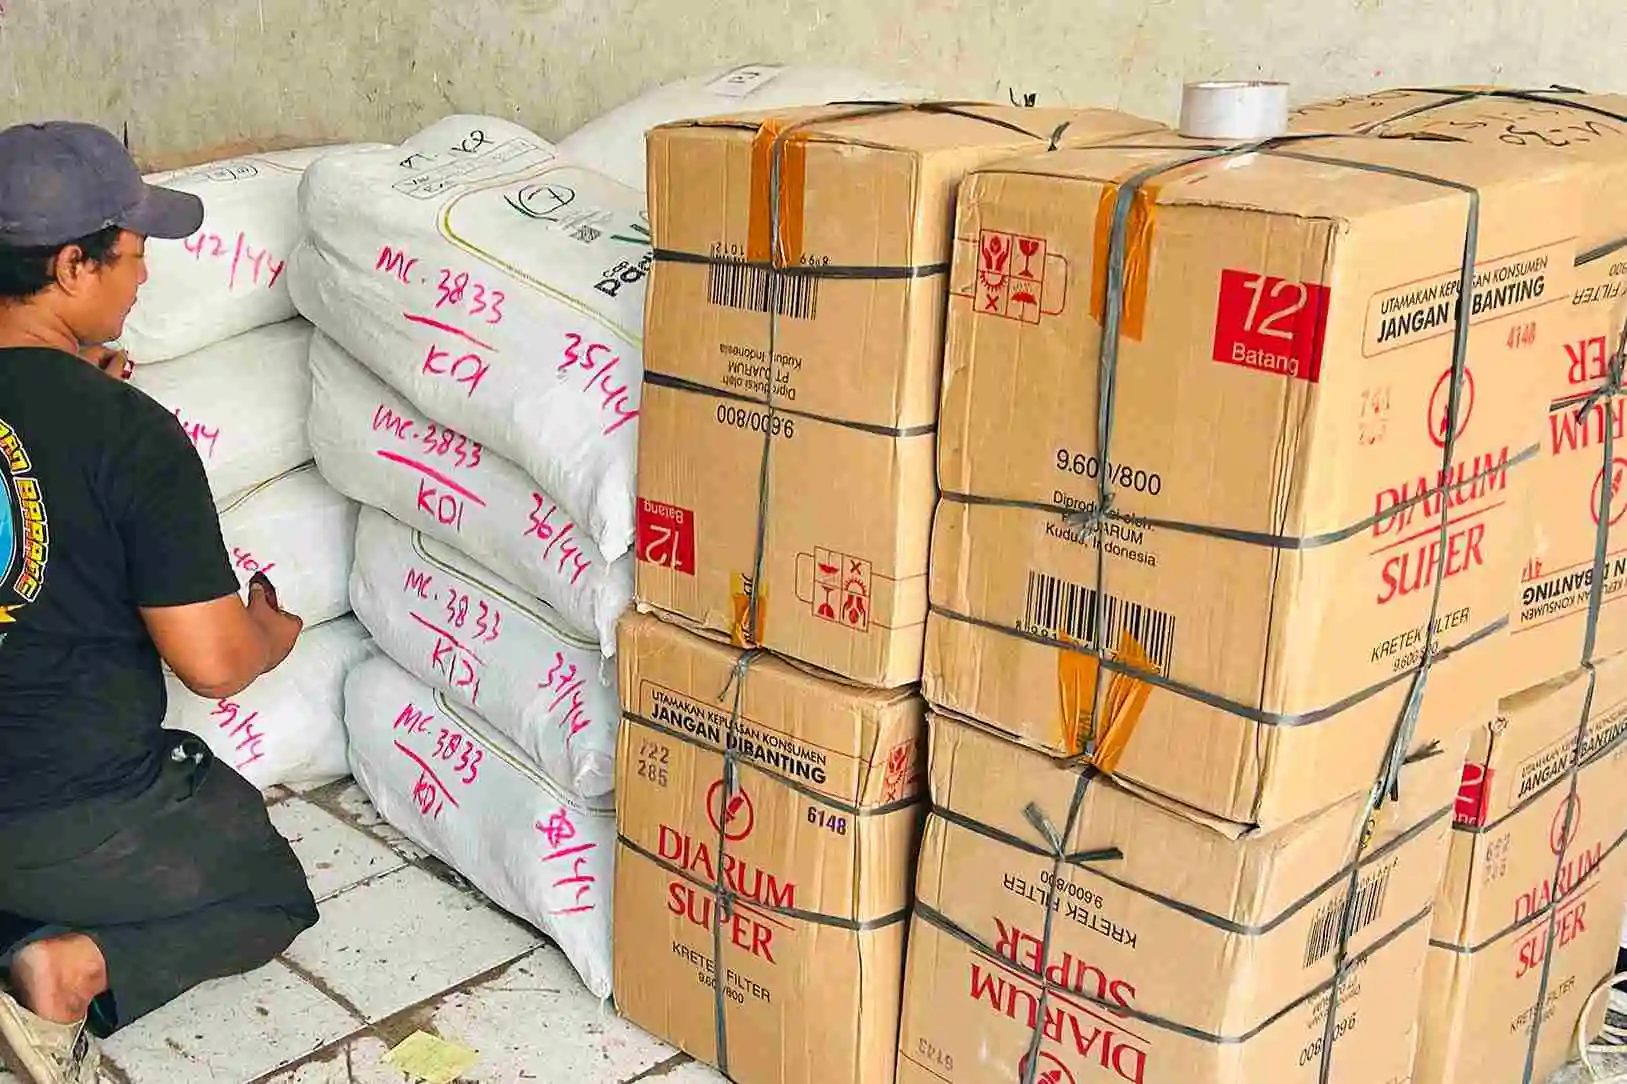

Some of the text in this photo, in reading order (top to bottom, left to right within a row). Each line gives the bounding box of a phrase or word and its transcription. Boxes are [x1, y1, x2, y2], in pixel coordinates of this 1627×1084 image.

[1243, 275, 1308, 340] 12
[1380, 285, 1439, 315] UTAMAKAN
[1492, 255, 1549, 284] KONSUMEN
[1376, 302, 1450, 344] JANGAN
[1231, 342, 1301, 376] Batang
[716, 404, 794, 440] 9.600/800
[644, 523, 684, 570] 12
[1434, 606, 1470, 634] ILTER
[651, 687, 705, 717] UTAMAKAN
[761, 732, 827, 766] KONSUMEN
[651, 704, 827, 785] JANGAN DIBANTING
[806, 805, 849, 836] 6148
[658, 823, 796, 910] DJARUM
[1064, 902, 1138, 950] KRETEK
[672, 940, 771, 1004] KRETE FILTER
[993, 917, 1137, 1020] SUPER
[968, 963, 1148, 1084] DJARUM
